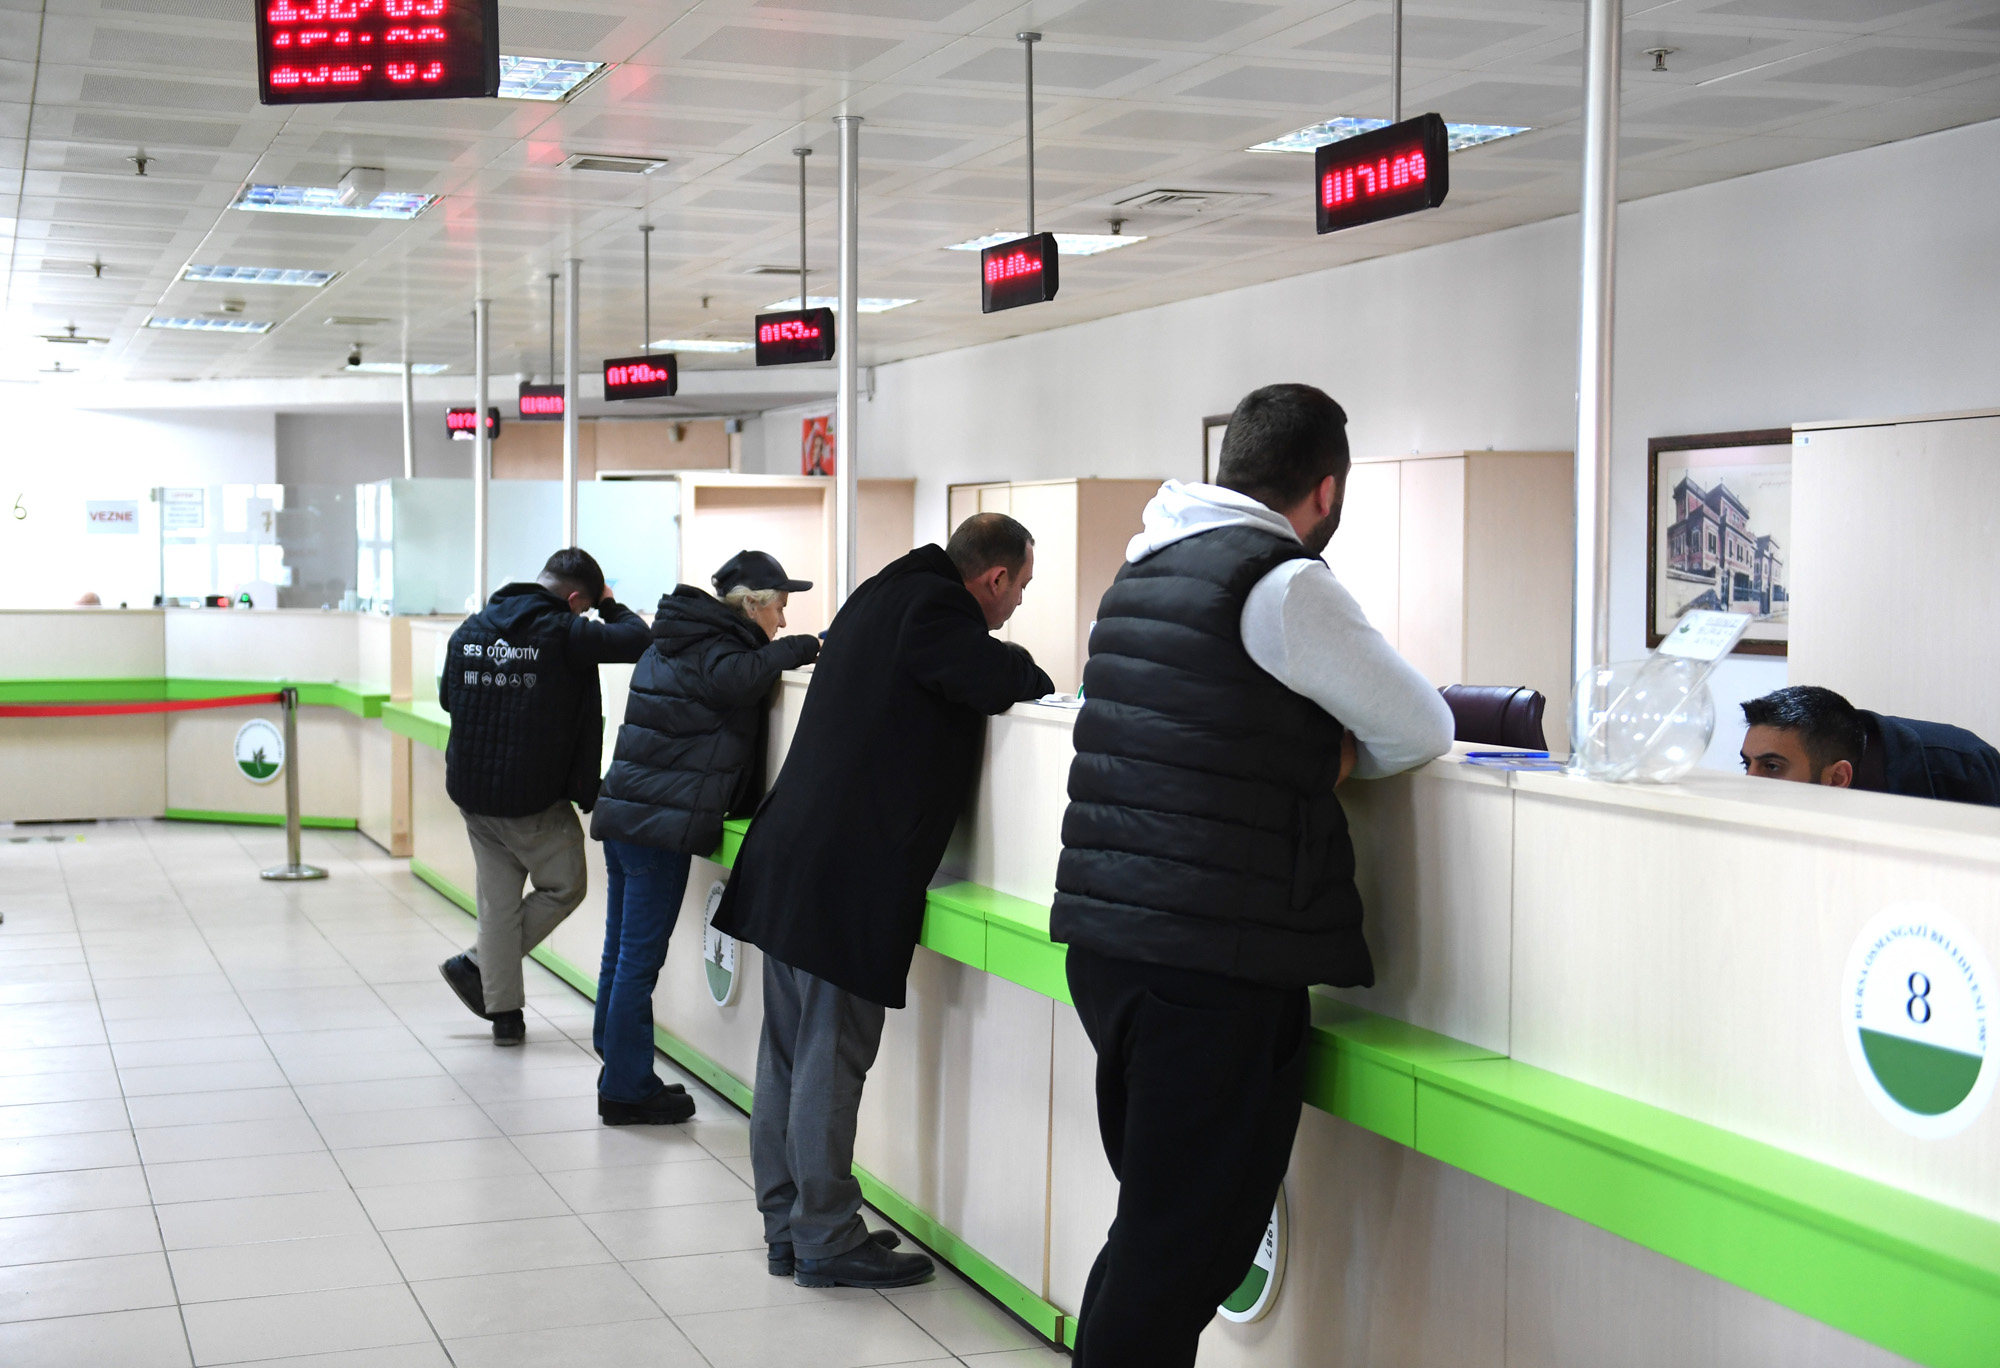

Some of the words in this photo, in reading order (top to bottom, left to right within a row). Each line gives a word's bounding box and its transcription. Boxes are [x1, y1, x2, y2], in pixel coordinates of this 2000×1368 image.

[13, 493, 28, 520] 6
[89, 511, 134, 523] VEZNE
[463, 644, 482, 656] SES
[486, 645, 539, 661] OTOMOTİV
[464, 671, 479, 686] FIAT
[1906, 971, 1931, 1024] 8
